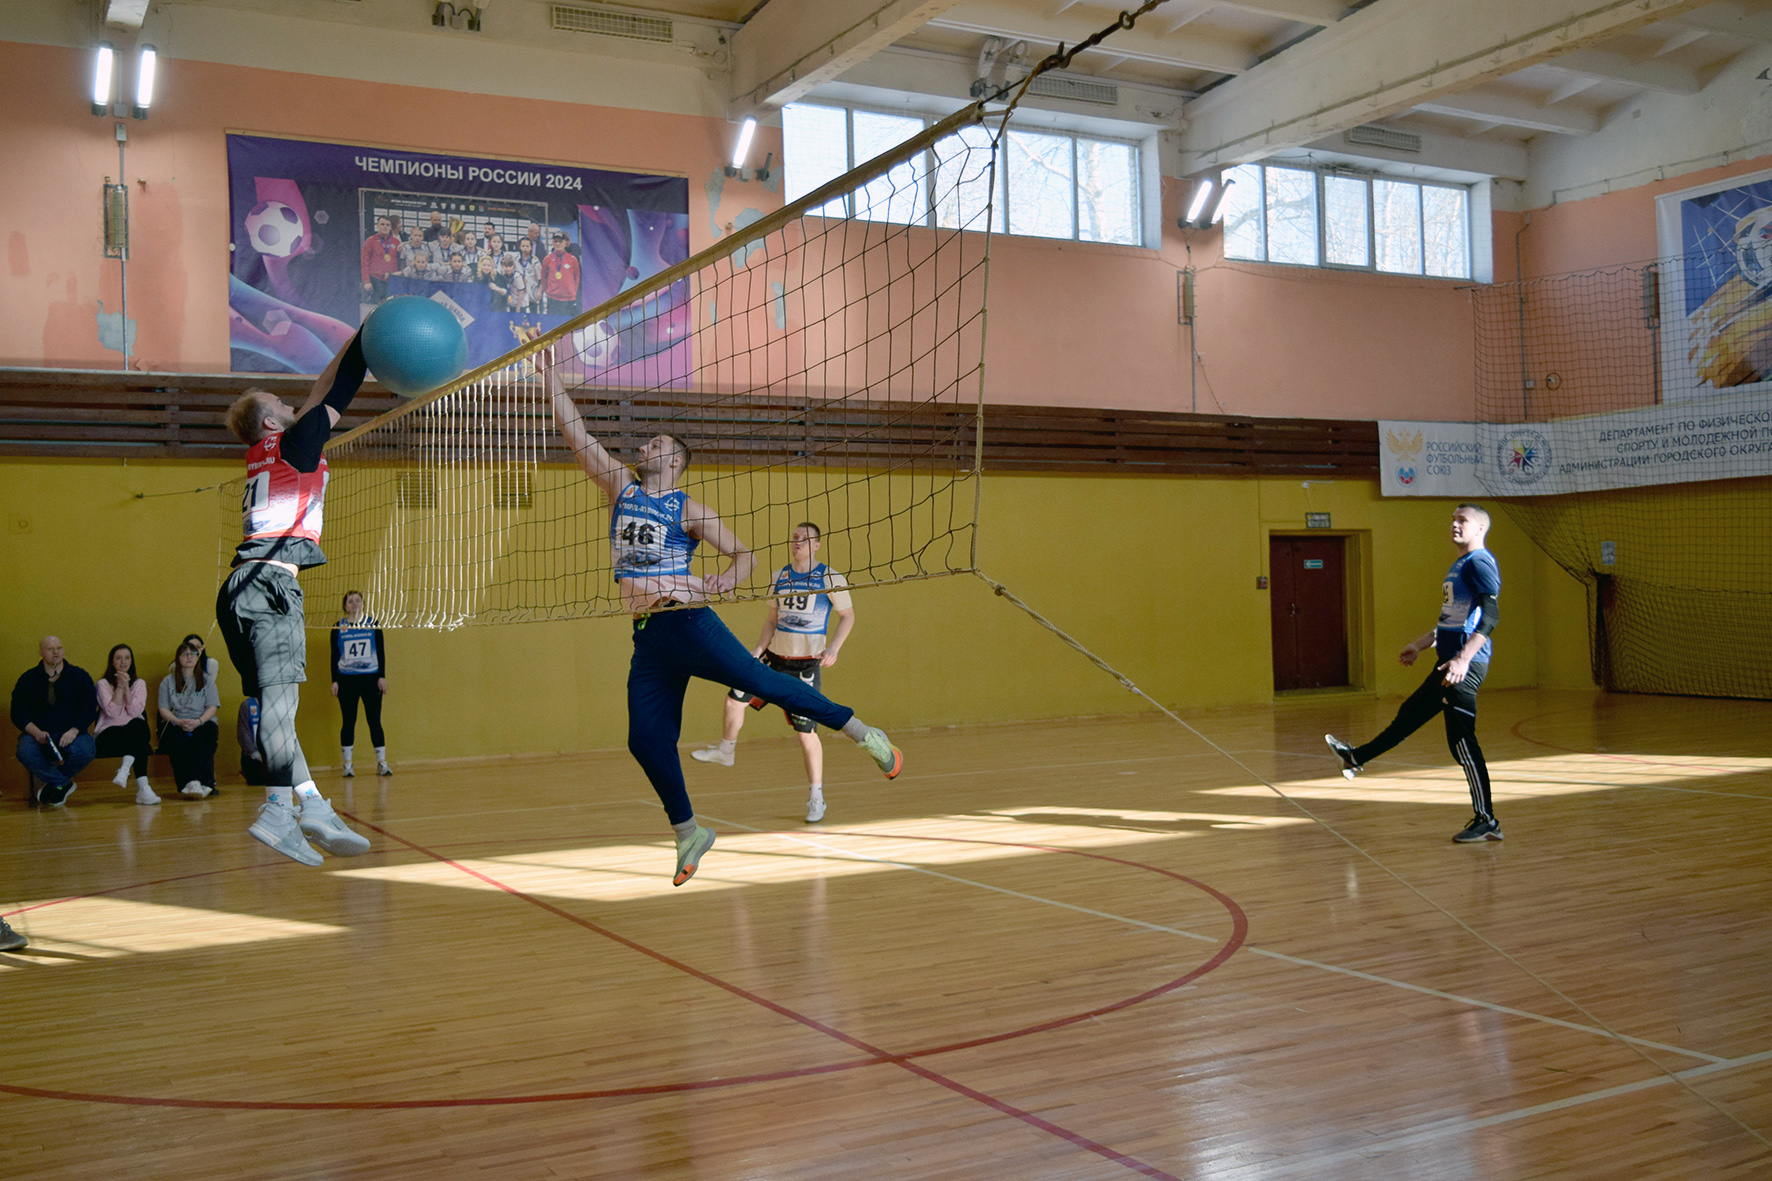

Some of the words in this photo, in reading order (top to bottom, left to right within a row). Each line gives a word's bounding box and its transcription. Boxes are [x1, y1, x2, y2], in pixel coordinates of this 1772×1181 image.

[354, 156, 463, 180] ЧЕМПИОНЫ
[468, 167, 541, 187] РОССИИ
[545, 174, 583, 190] 2024
[1599, 422, 1674, 443] ДЕПАРТАМЕНТ
[1678, 421, 1695, 432] ПО
[1699, 412, 1772, 429] ФИЗИЧЕСКО
[1616, 438, 1658, 454] СПОРТУ
[1662, 438, 1669, 448] И
[1672, 426, 1757, 447] МОЛОДЕЖНОЙ
[1426, 441, 1482, 453] РОССИЙСКИЙ
[1426, 453, 1482, 464] ФУТБОЛЬНЫЙ
[1426, 465, 1451, 475] СОЮЗ
[1559, 455, 1650, 474] АДМИНИСТРАЦИИ
[1653, 446, 1726, 463] ГОРОДСКОГО
[242, 478, 259, 513] 21
[622, 521, 656, 546] 46
[783, 594, 808, 611] 49
[349, 641, 367, 657] 47
